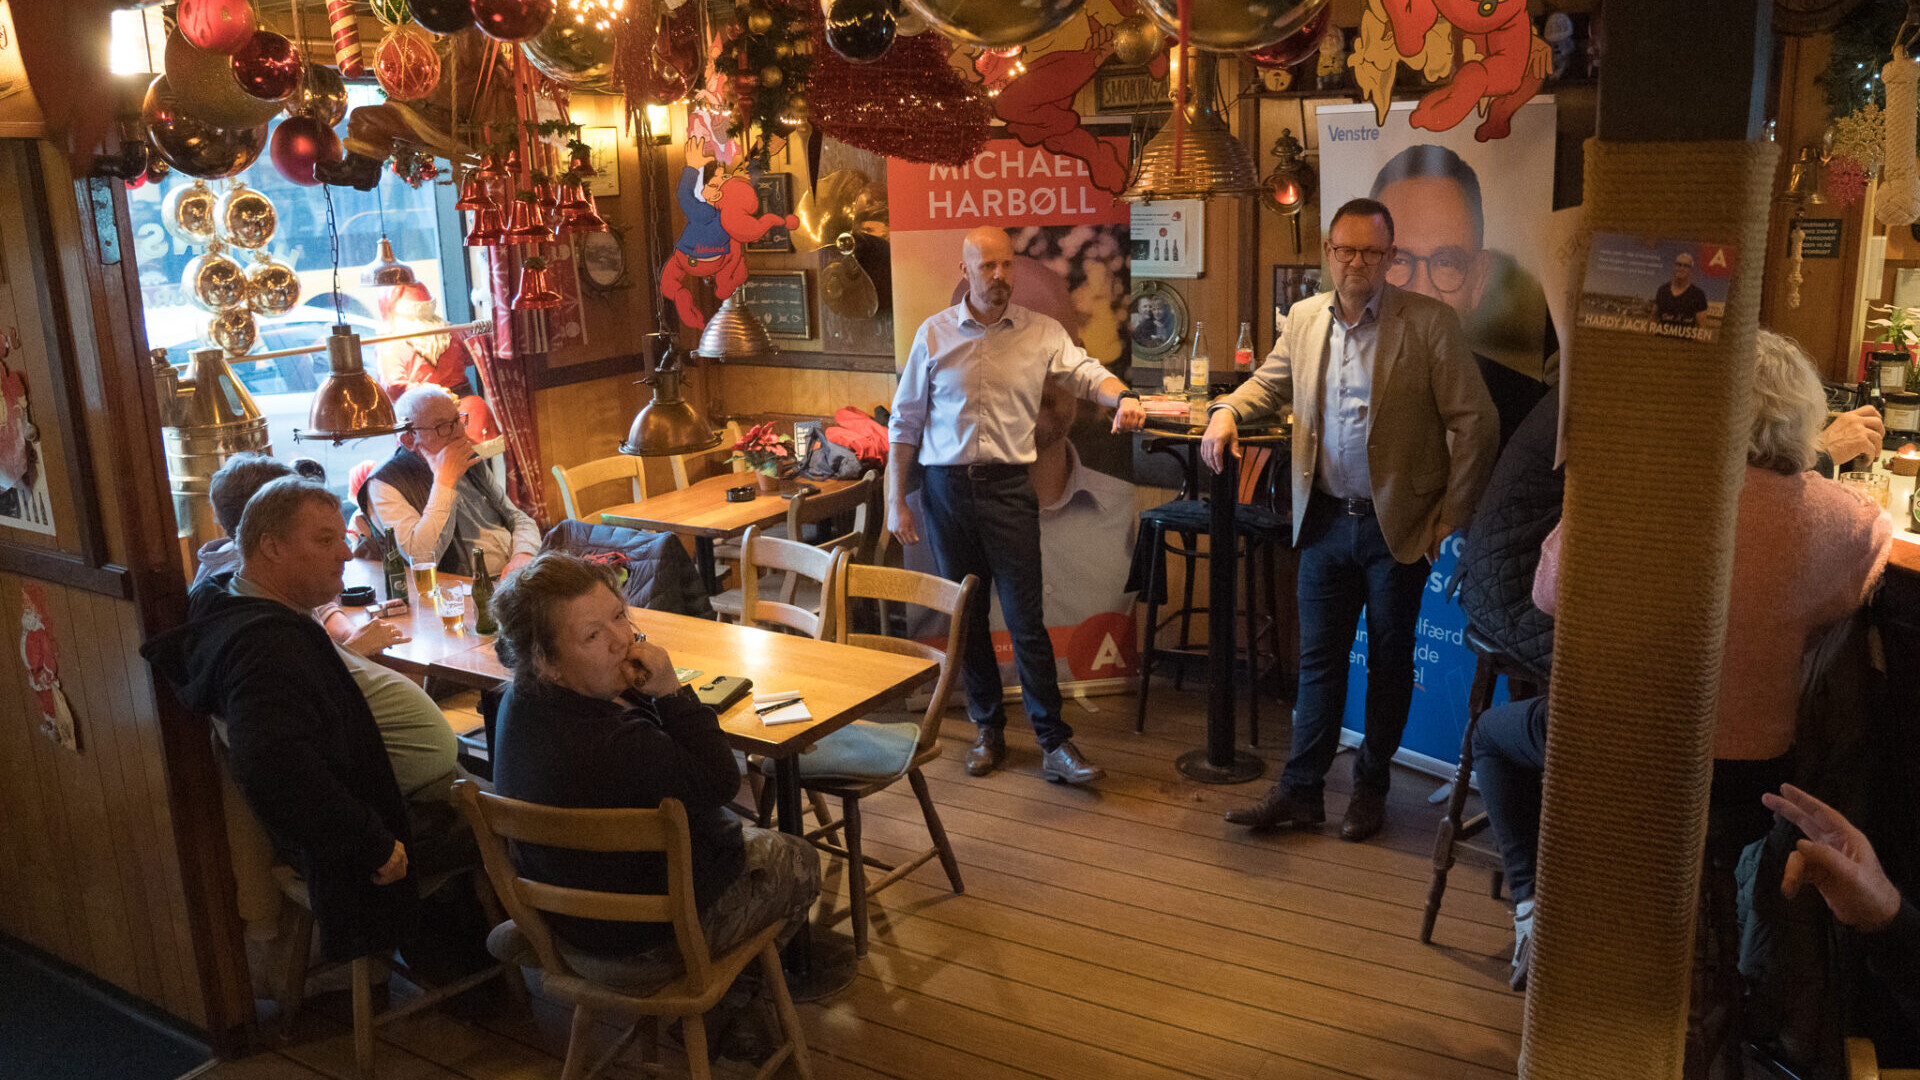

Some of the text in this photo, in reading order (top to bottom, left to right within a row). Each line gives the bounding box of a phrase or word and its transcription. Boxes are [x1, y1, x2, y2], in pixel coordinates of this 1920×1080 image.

[1328, 124, 1380, 142] Venstre
[928, 186, 1097, 219] HARBØLL
[1709, 248, 1727, 268] A
[1584, 314, 1713, 341] HARDY JACK RASMUSSEN
[1091, 632, 1127, 671] A
